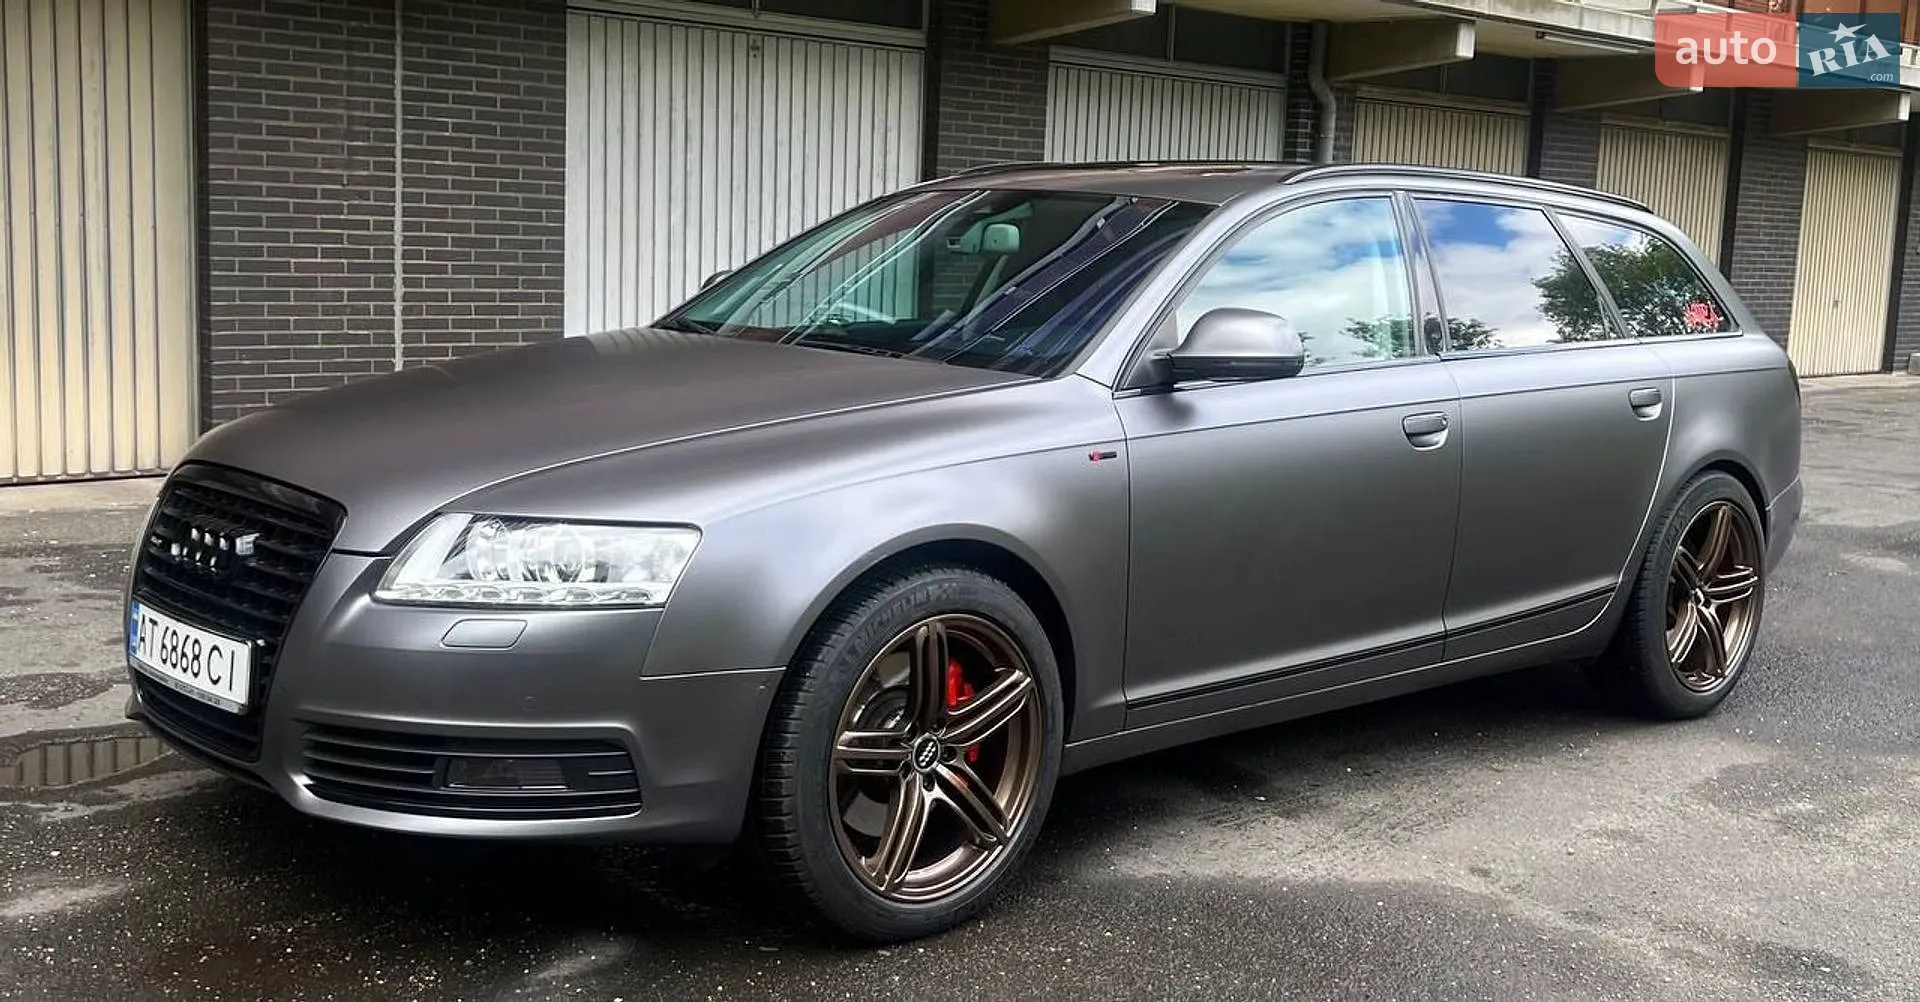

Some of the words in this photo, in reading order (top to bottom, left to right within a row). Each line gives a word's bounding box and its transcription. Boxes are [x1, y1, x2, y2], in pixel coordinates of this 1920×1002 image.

[139, 613, 158, 661] AT
[160, 626, 202, 678] 6868
[207, 644, 235, 692] CI
